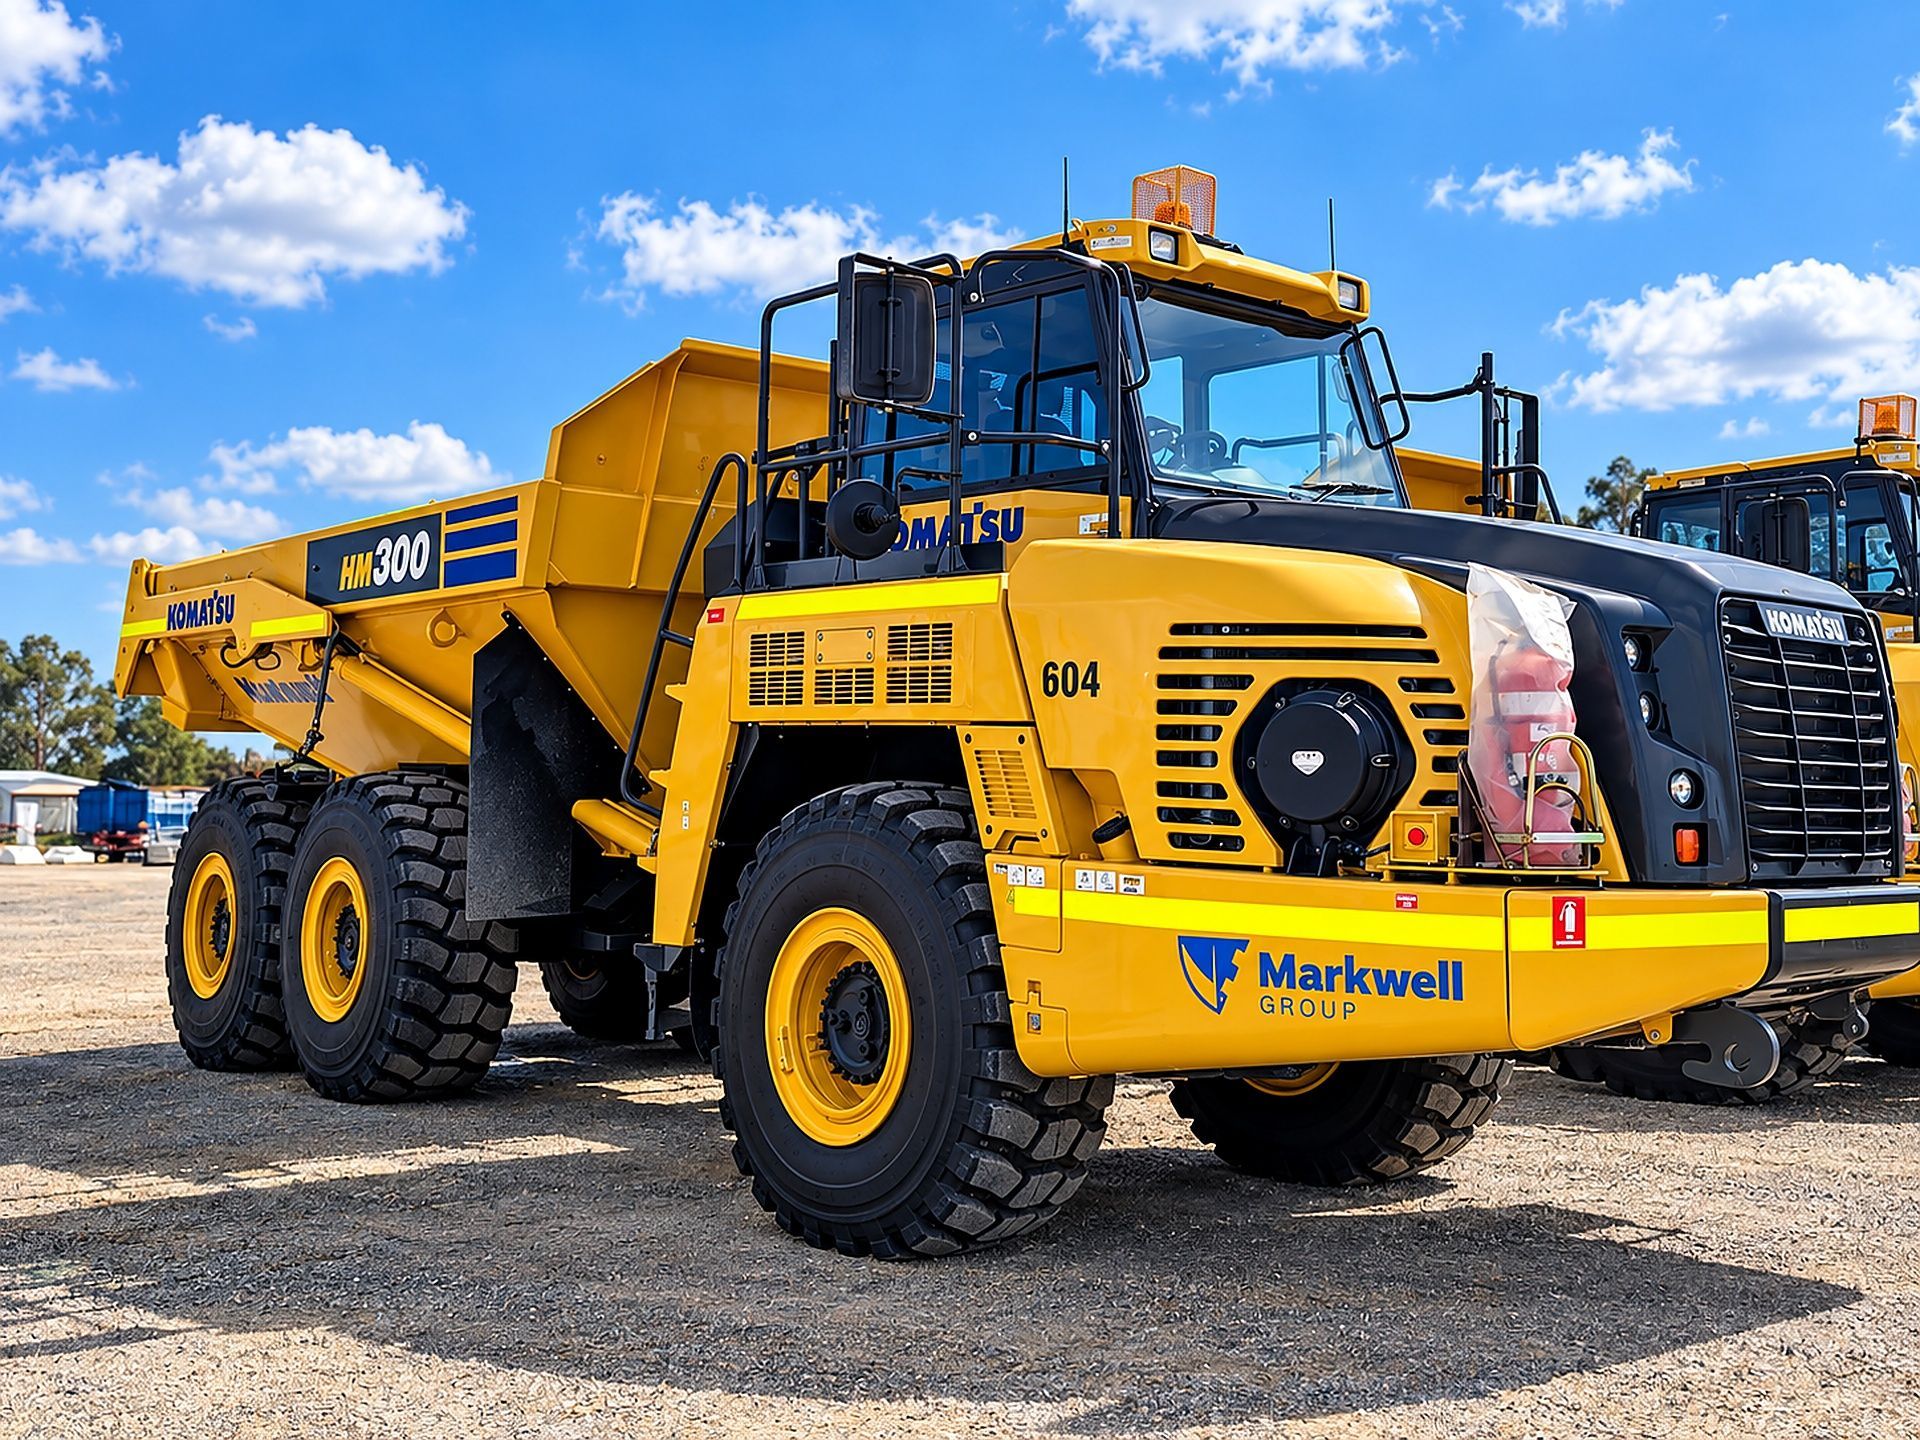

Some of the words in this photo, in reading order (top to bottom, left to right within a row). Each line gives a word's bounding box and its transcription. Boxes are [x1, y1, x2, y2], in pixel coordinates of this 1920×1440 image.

[338, 530, 430, 592] HM300
[166, 589, 236, 631] KOMATSU
[1764, 609, 1845, 642] KOMATSU
[1042, 661, 1101, 698] 604
[1258, 951, 1465, 1002] Markwell
[1259, 995, 1357, 1020] GROUP
